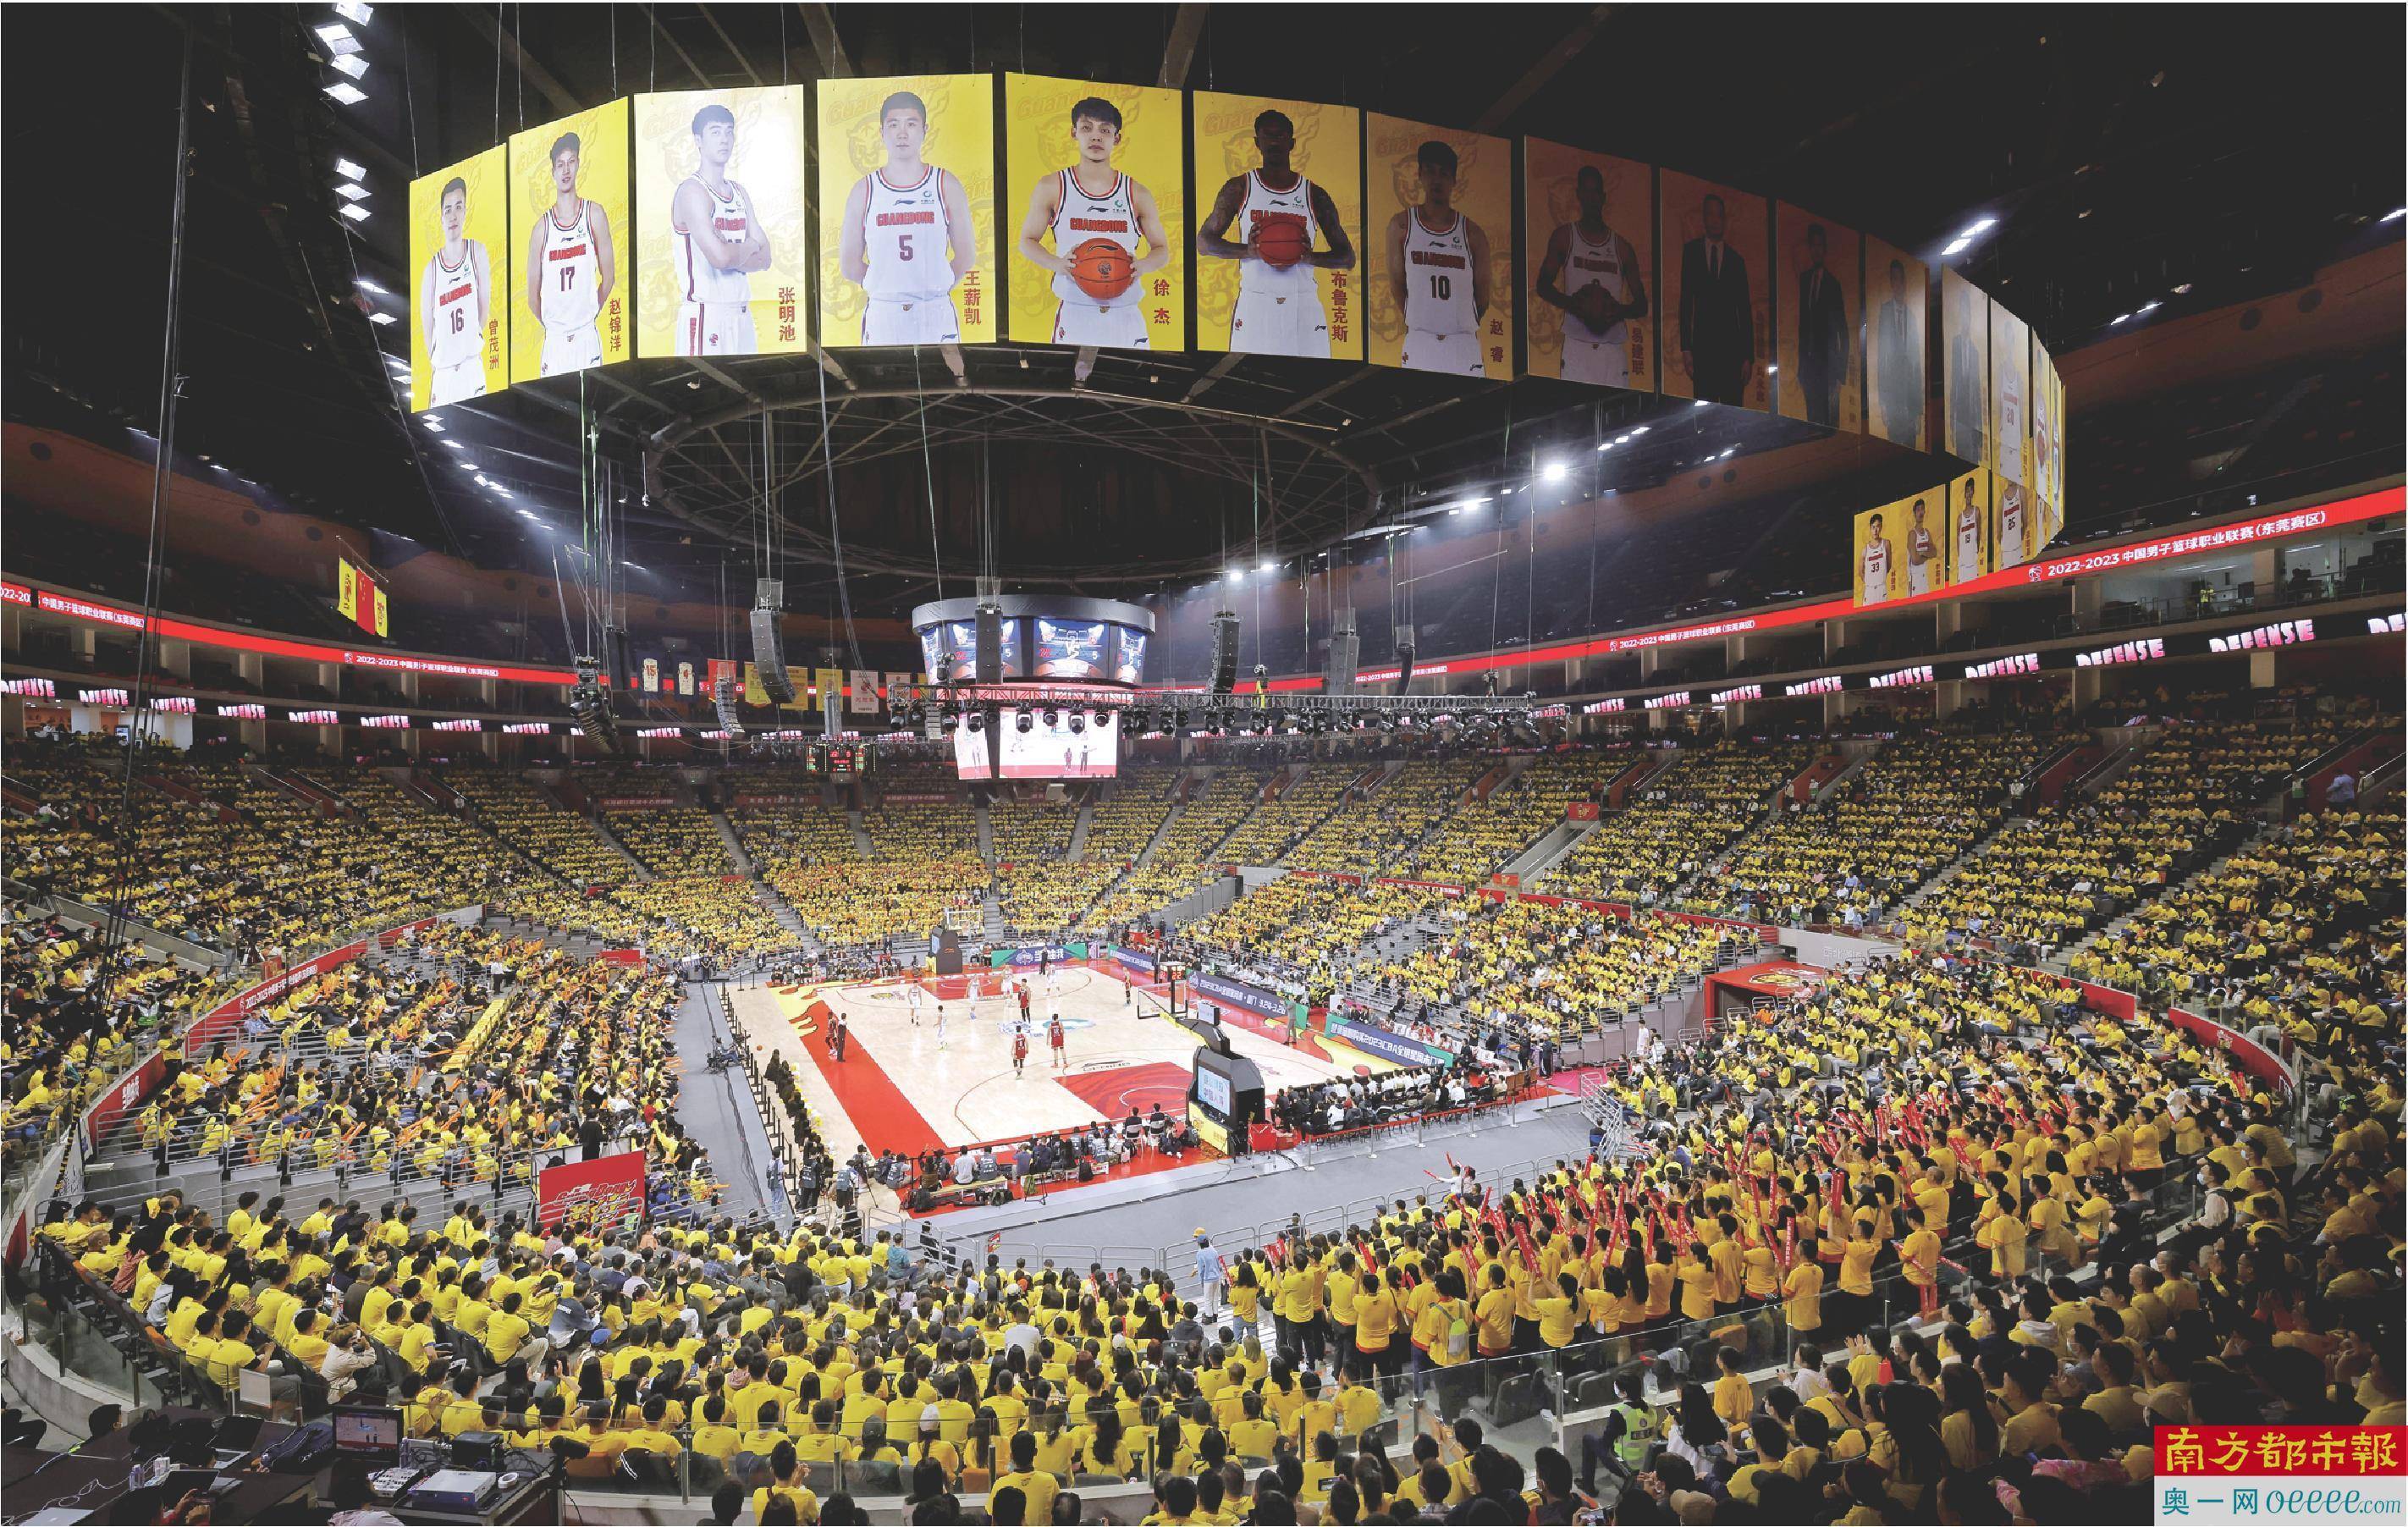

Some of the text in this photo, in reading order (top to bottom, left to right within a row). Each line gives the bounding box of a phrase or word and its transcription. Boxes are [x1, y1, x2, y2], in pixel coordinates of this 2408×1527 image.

[876, 211, 935, 227] GUANGDONG
[1070, 217, 1128, 234] GUANGDONG
[899, 234, 913, 262] 5
[559, 266, 576, 292] 17
[1429, 275, 1452, 301] 10
[964, 270, 982, 326] 王薪凯
[1154, 278, 1171, 326] 徐杰
[1331, 271, 1348, 343] 布鲁克斯
[449, 307, 465, 335] 16
[609, 297, 621, 352] 赵锦洋
[778, 286, 796, 342] 张明池
[1871, 561, 1880, 573] 33
[2047, 552, 2120, 577] 2022-2023
[2210, 619, 2317, 653] DEFENSE
[2075, 637, 2165, 667] DEFENSE
[1870, 664, 1934, 688] DEFENSE
[1965, 652, 2041, 679] DEFENSE
[79, 688, 129, 705] DEFENSE
[1711, 684, 1762, 703] DEFENSE
[1786, 675, 1843, 697] DEFENSE
[218, 703, 266, 719] DEFENSE
[1644, 691, 1690, 709] DEFENSE
[289, 710, 339, 725] DEFENSE
